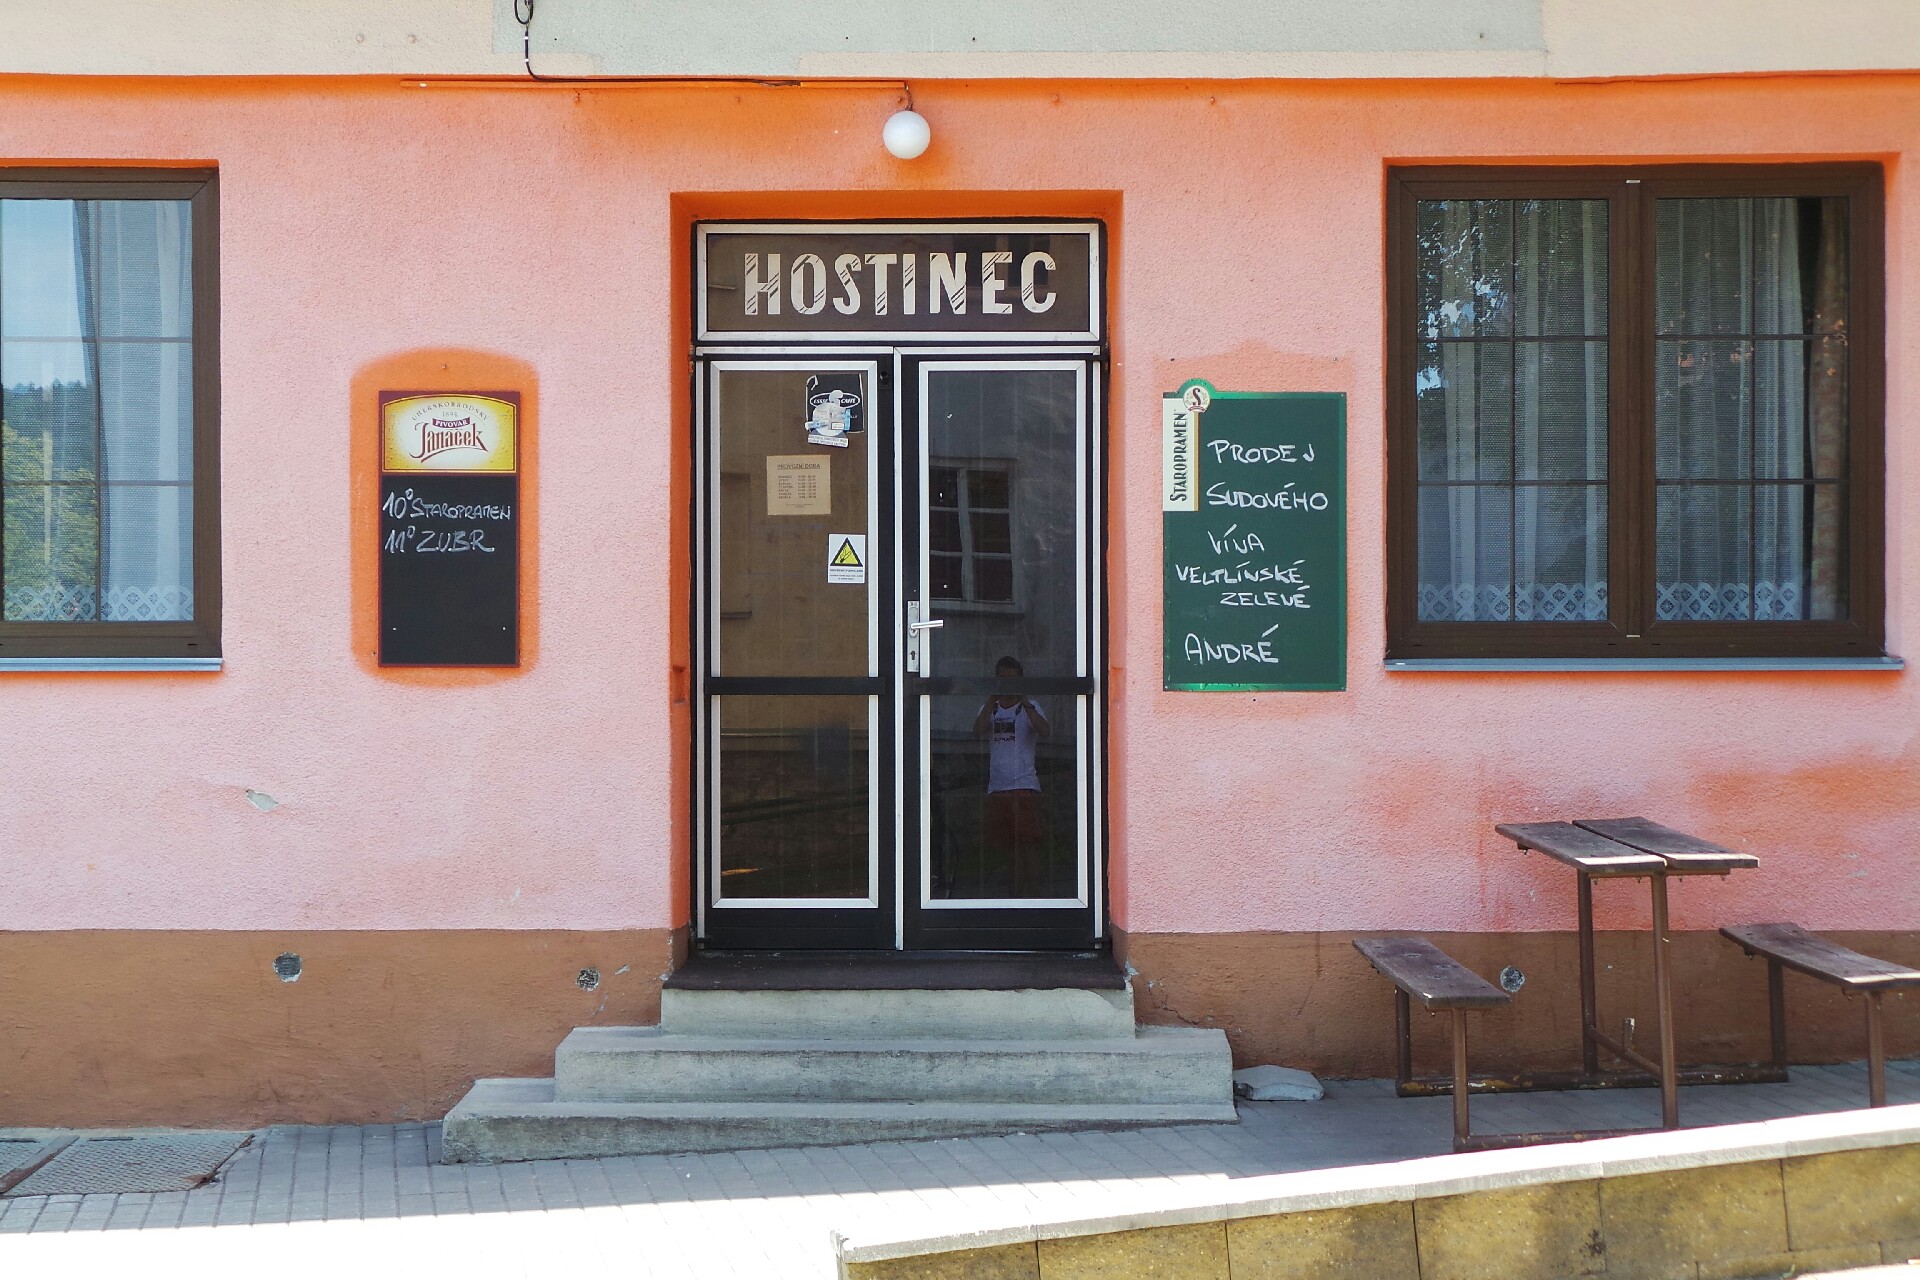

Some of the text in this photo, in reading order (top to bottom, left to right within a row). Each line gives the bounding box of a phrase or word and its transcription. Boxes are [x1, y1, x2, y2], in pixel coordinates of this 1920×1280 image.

[744, 251, 1057, 316] HOSTINEC
[434, 419, 469, 428] PIVOVAR
[1206, 482, 1329, 512] SUDOVÉHO
[415, 529, 496, 553] ZUBR
[1207, 523, 1266, 556] VÍNA
[1175, 559, 1306, 586] VELTLÍNSKÉ
[1219, 585, 1312, 609] ZELENÉ
[1184, 624, 1280, 665] ANDRÉ
